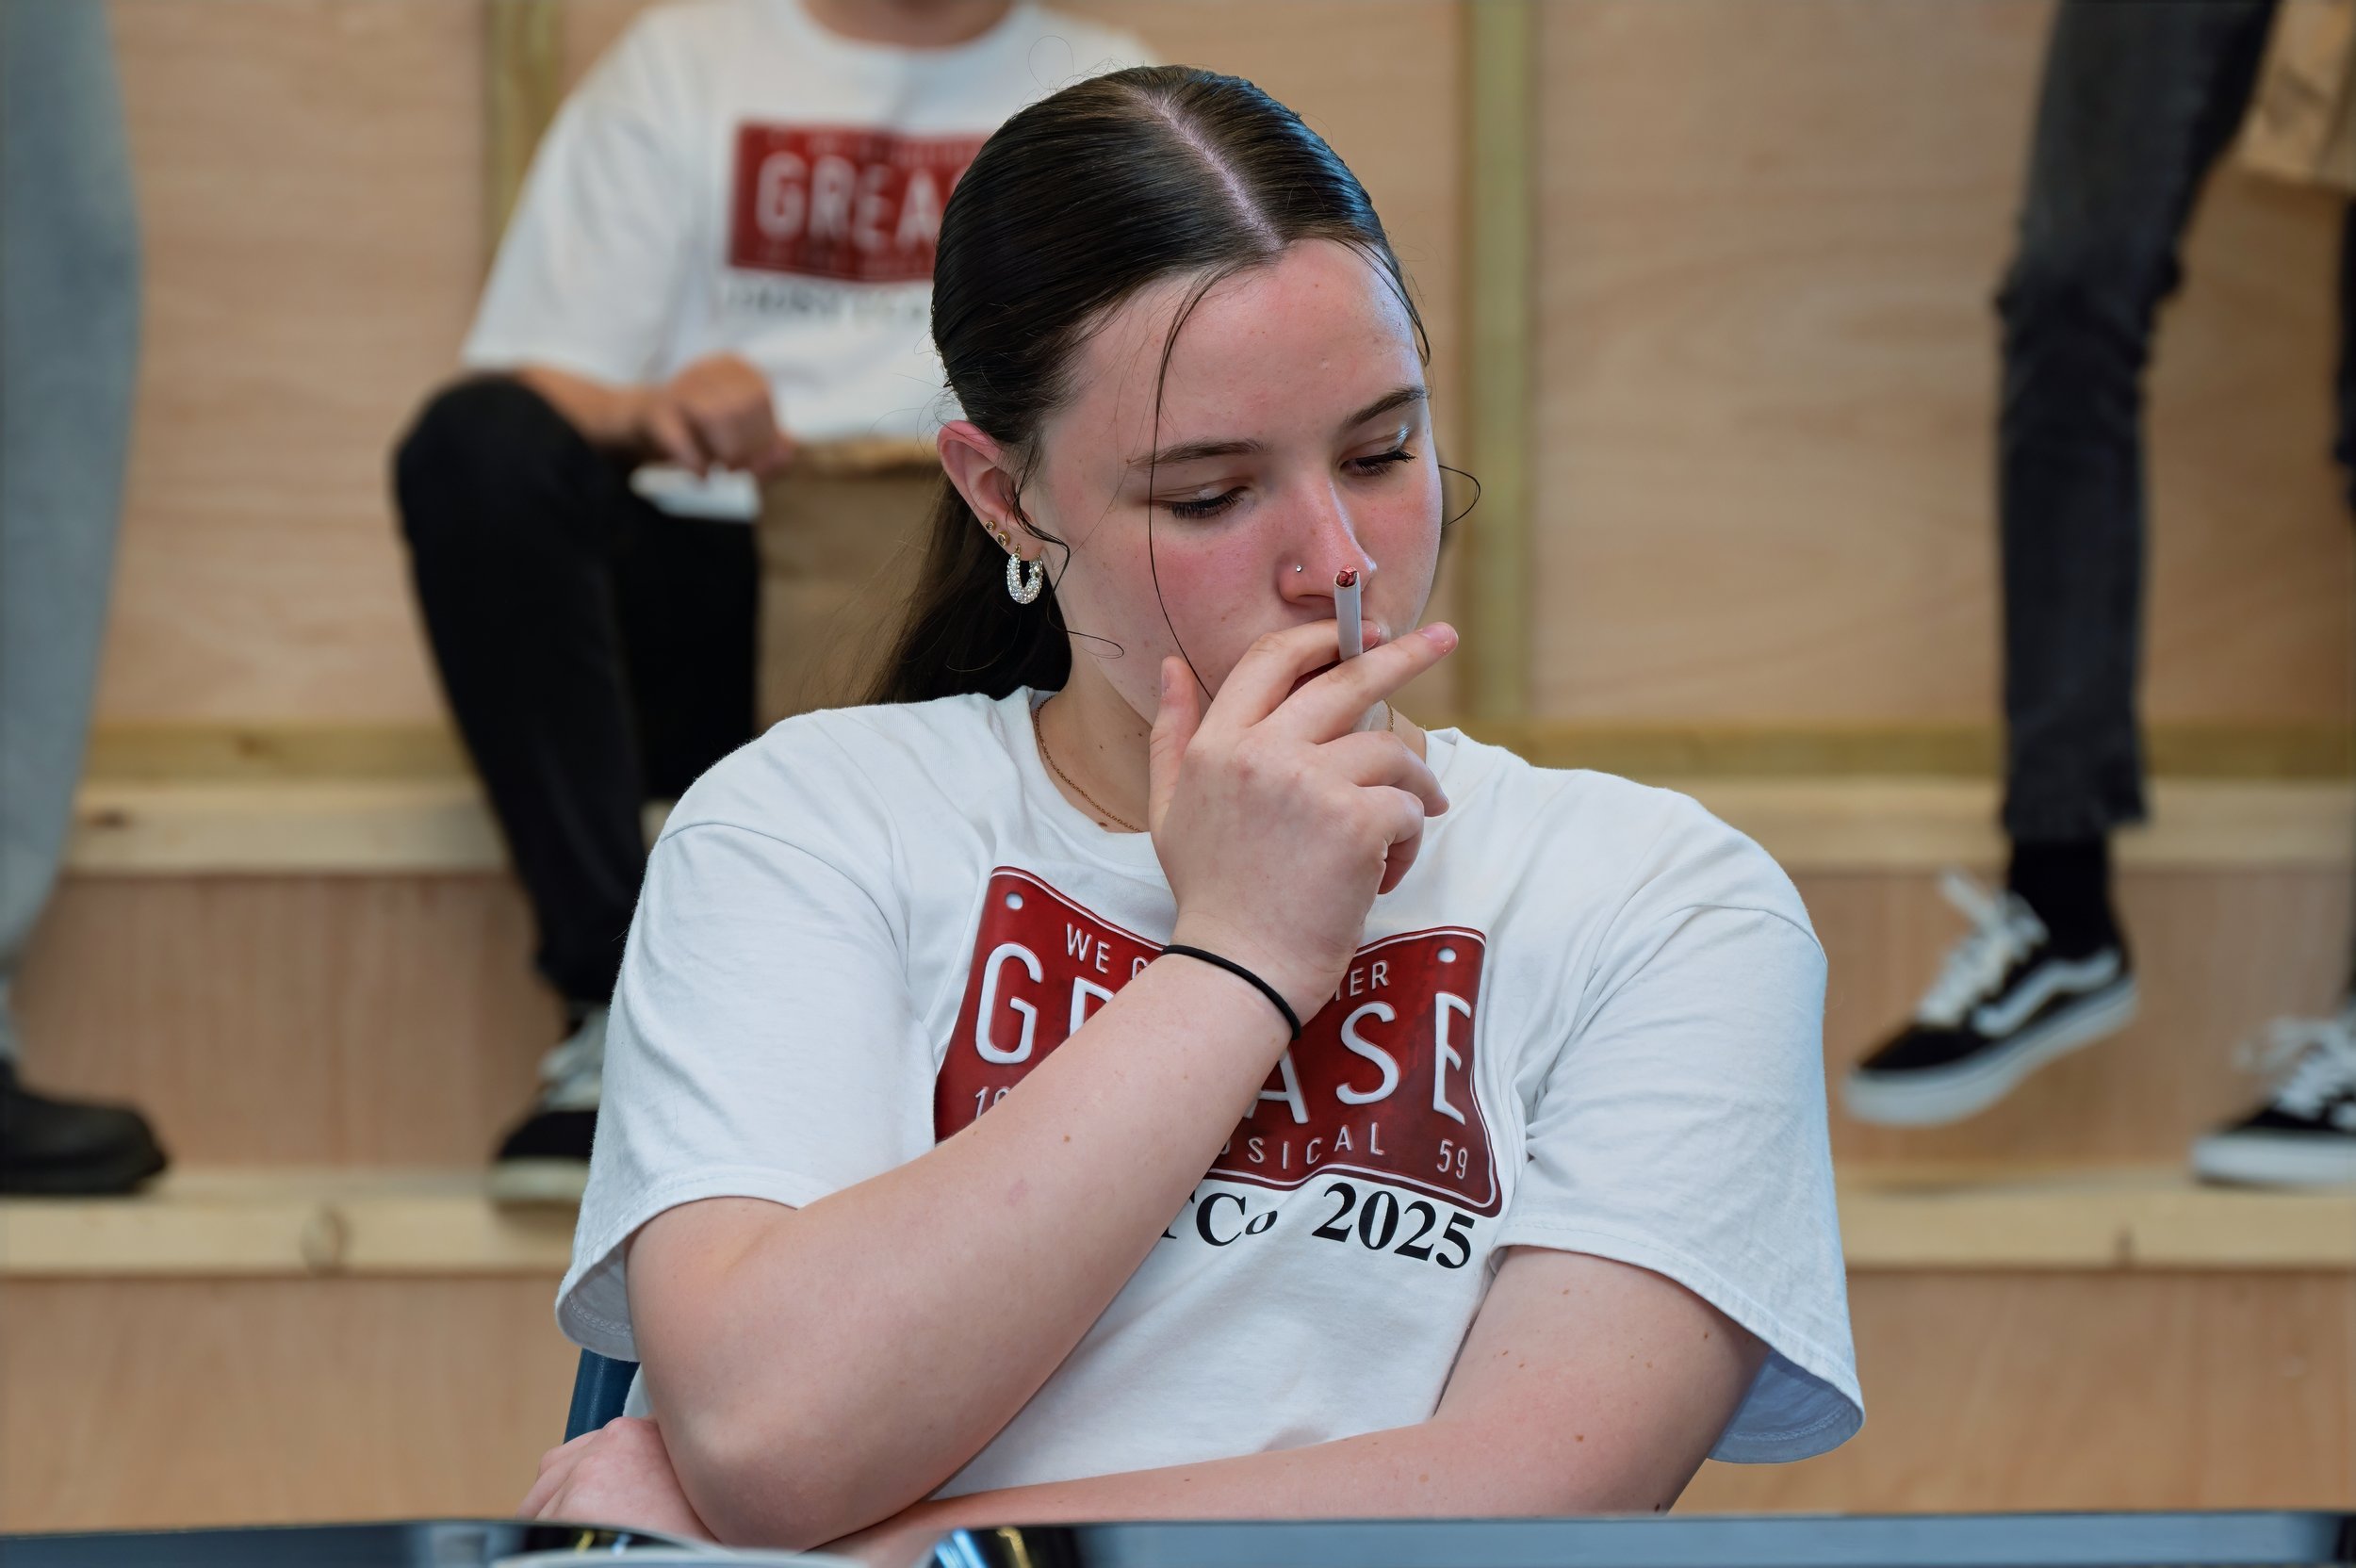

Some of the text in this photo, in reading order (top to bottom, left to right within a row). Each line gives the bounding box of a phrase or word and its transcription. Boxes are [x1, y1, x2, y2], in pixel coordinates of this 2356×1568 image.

[755, 150, 968, 252] GREA
[1066, 923, 1111, 974] WE
[1334, 960, 1390, 1002] ER
[1221, 1121, 1385, 1170] SICAL
[1436, 1138, 1468, 1180] 59
[1161, 1182, 1476, 1269] Co 2025
